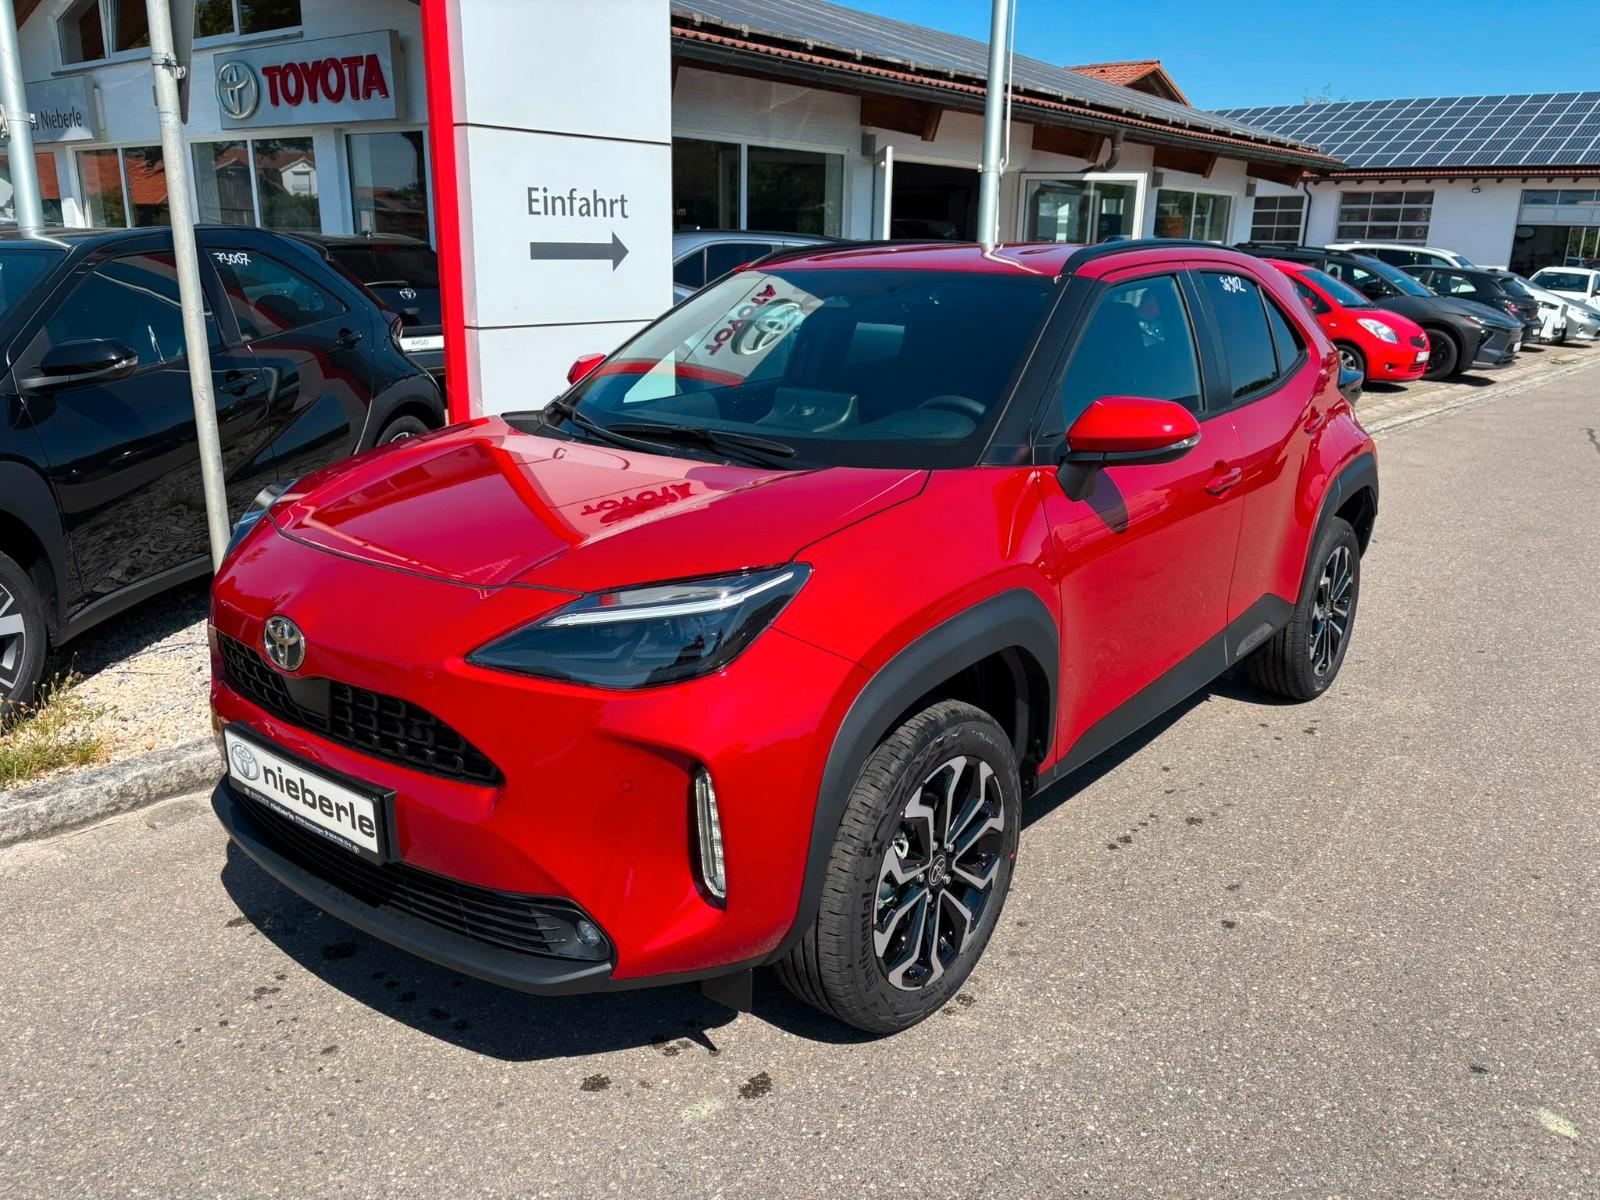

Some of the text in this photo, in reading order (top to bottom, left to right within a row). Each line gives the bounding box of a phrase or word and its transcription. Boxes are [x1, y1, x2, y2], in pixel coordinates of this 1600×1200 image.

[261, 53, 389, 107] TOYOTA
[40, 106, 82, 129] Nieberle
[527, 186, 629, 219] Einfahrt
[262, 765, 376, 839] nieberle
